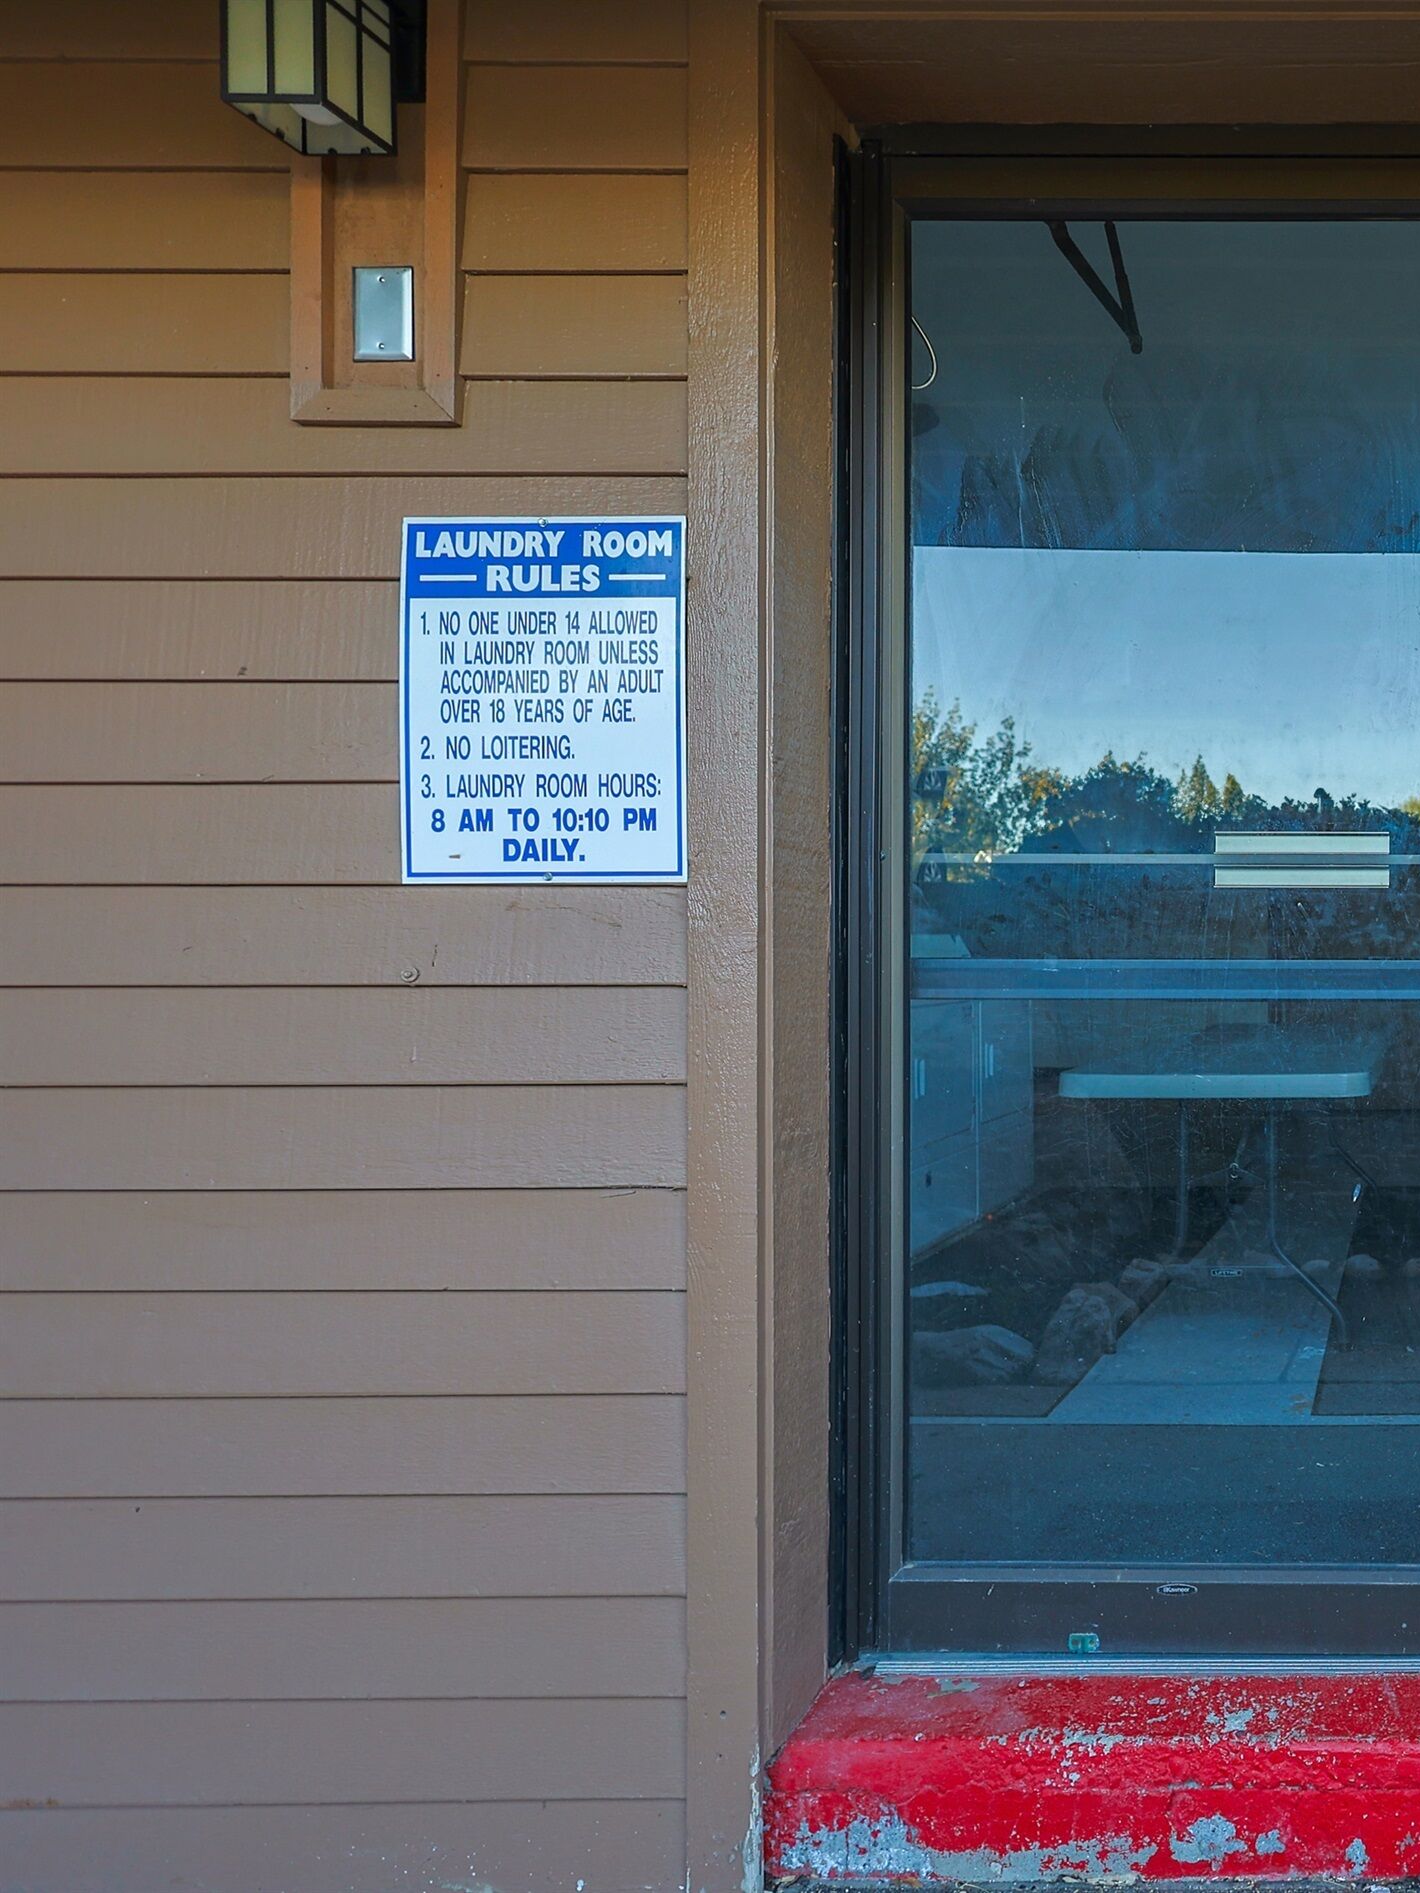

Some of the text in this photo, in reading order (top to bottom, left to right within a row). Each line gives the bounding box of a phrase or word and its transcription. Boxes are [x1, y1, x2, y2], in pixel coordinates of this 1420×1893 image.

[416, 530, 672, 558] LAUNDRY ROOM
[487, 565, 600, 591] RULES
[421, 610, 657, 635] 1. NO ONE UNDER 14 ALLOWED
[441, 640, 658, 665] IN LAUNDRY ROOM UNLESS
[441, 670, 663, 694] ACCOMPANIED BY AN ADULT
[441, 698, 635, 723] OVER 18 YEARS OF AGE.
[421, 735, 574, 760] 2. NO LOITERING.
[421, 773, 660, 798] 3. LAUNDRY ROOM HOURS:
[432, 808, 656, 832] 8 AM TO 10:10 PM
[503, 839, 585, 861] DAILY.
